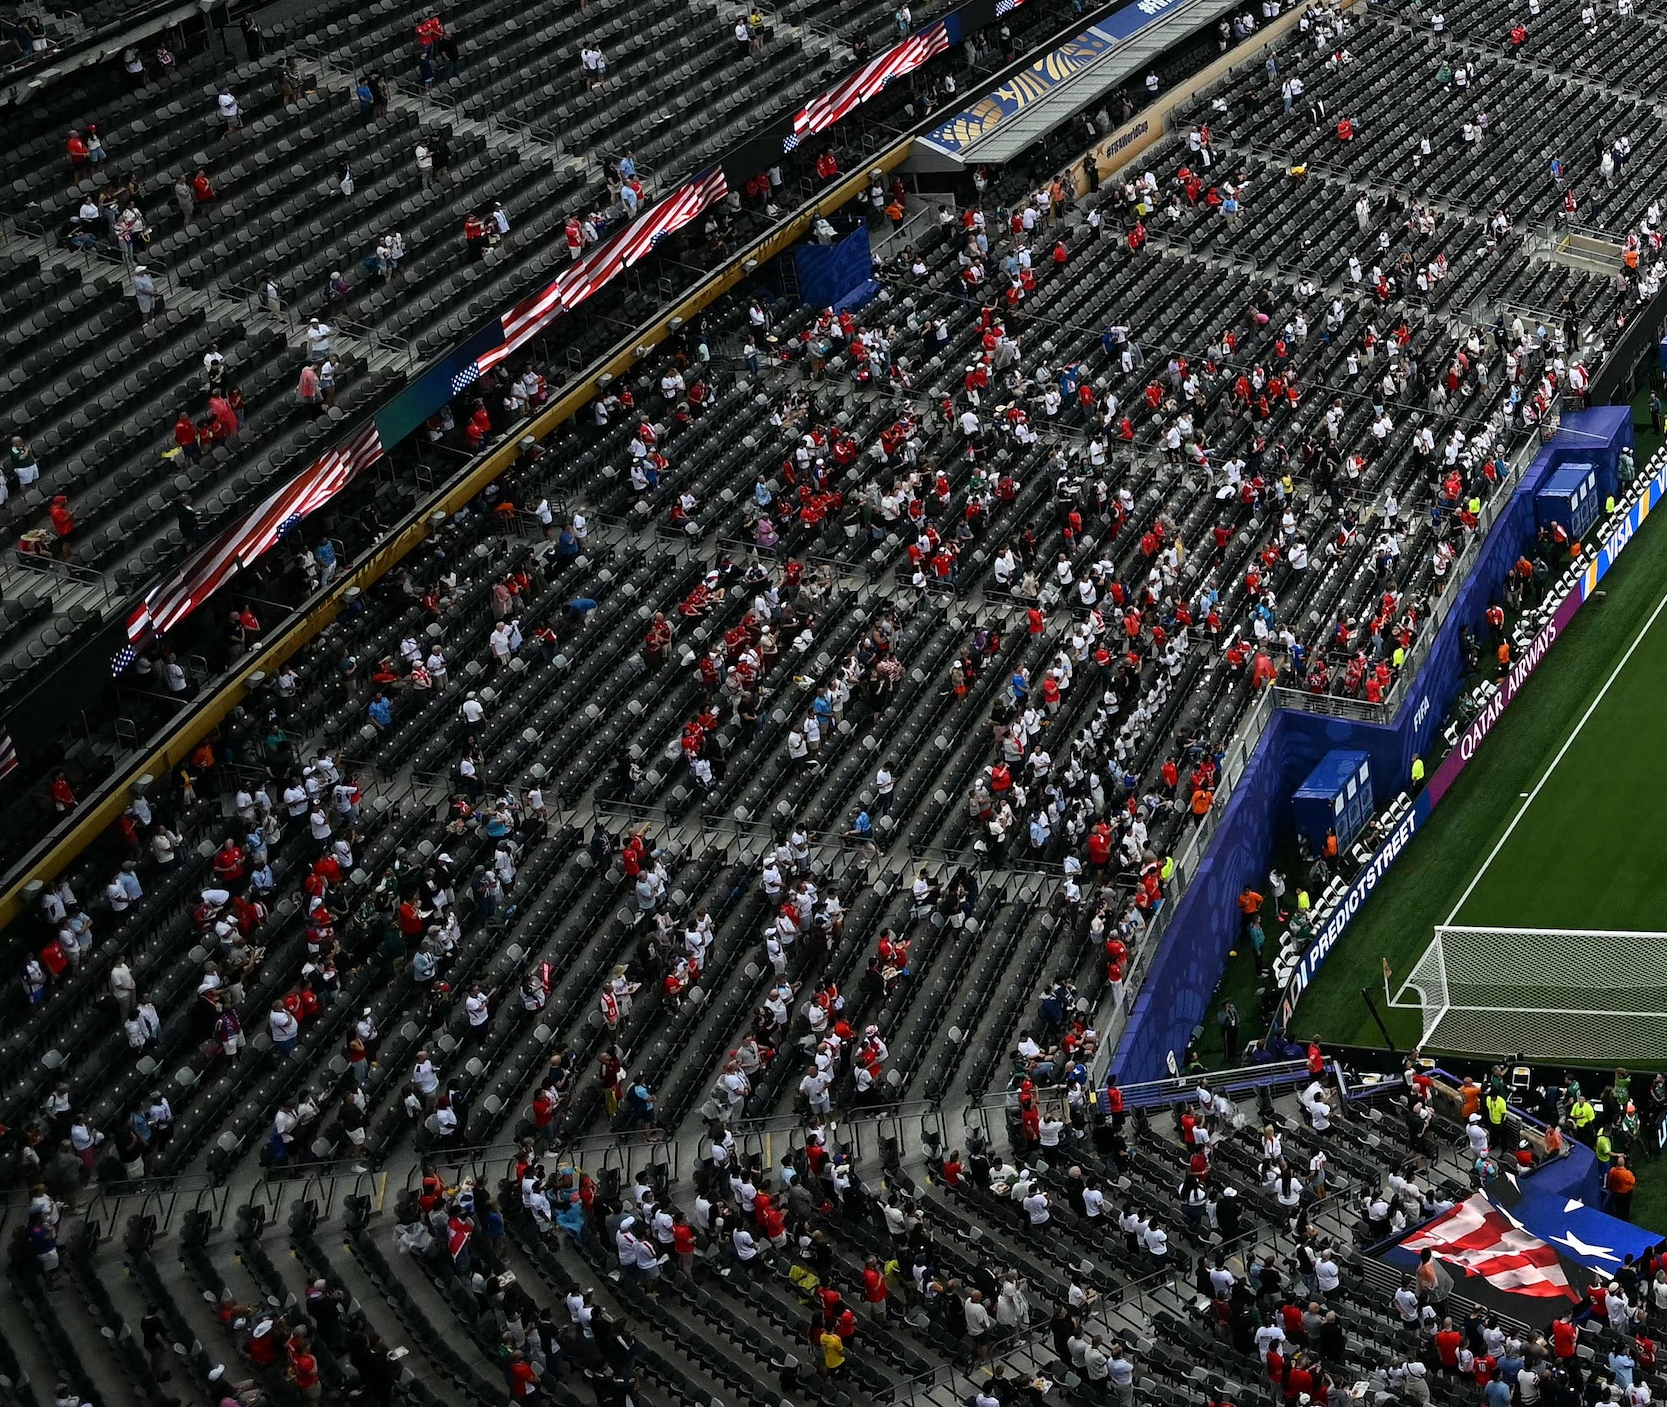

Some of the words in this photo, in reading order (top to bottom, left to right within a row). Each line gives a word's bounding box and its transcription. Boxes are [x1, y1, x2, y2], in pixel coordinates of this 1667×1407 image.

[1106, 119, 1149, 159] #FIFAWorldCup
[1603, 516, 1633, 565] VISA
[1459, 690, 1505, 761] QATAR
[1507, 618, 1557, 700] AIRWAYS
[1413, 695, 1430, 733] FIFA
[1282, 960, 1309, 1029] ADI
[1309, 809, 1416, 972] PREDICTSTREET
[1478, 1362, 1487, 1372] 10
